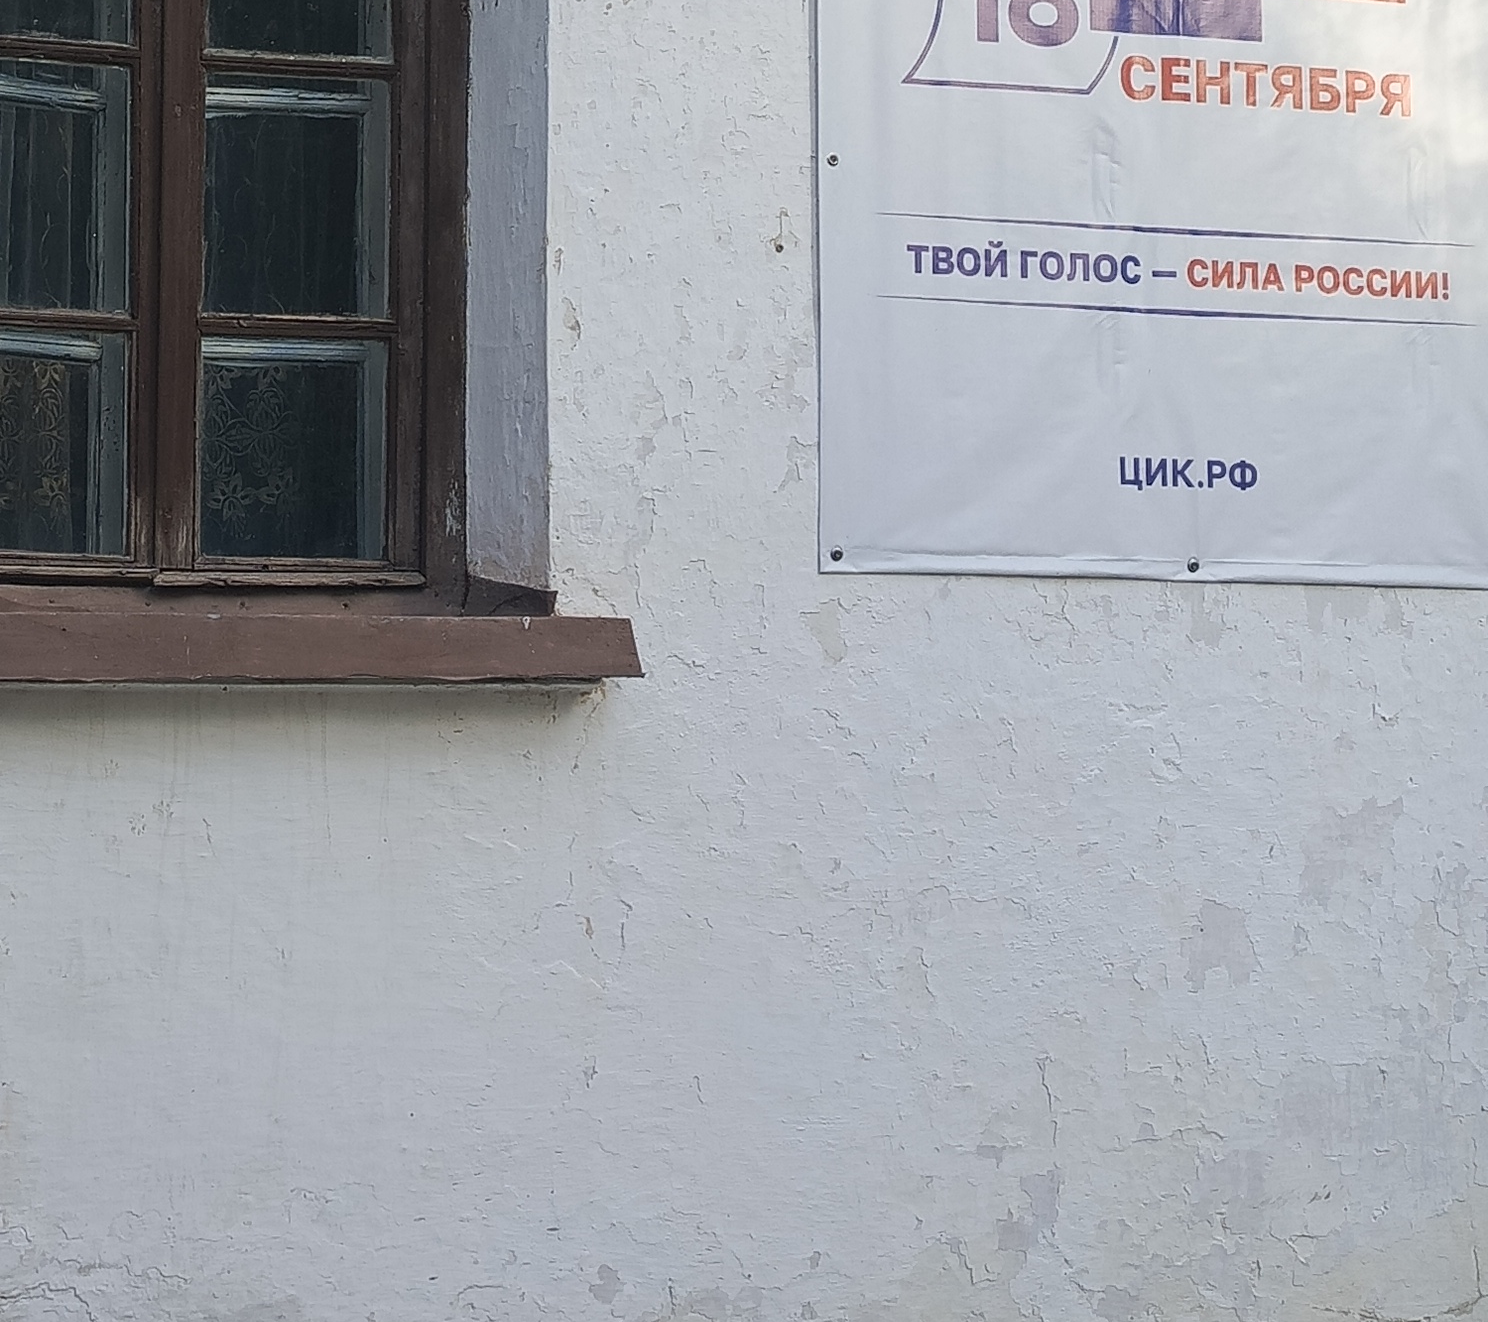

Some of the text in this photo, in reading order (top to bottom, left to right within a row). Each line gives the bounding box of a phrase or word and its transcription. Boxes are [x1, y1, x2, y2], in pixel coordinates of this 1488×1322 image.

[1120, 56, 1412, 117] СЕНТЯБРЯ
[907, 241, 1008, 279] ТВОЙ
[1020, 251, 1142, 285] ГОЛОС
[1187, 259, 1284, 292] СИЛА
[1295, 266, 1450, 301] РОССИИ!
[1119, 456, 1258, 491] ЦИК.РФ
